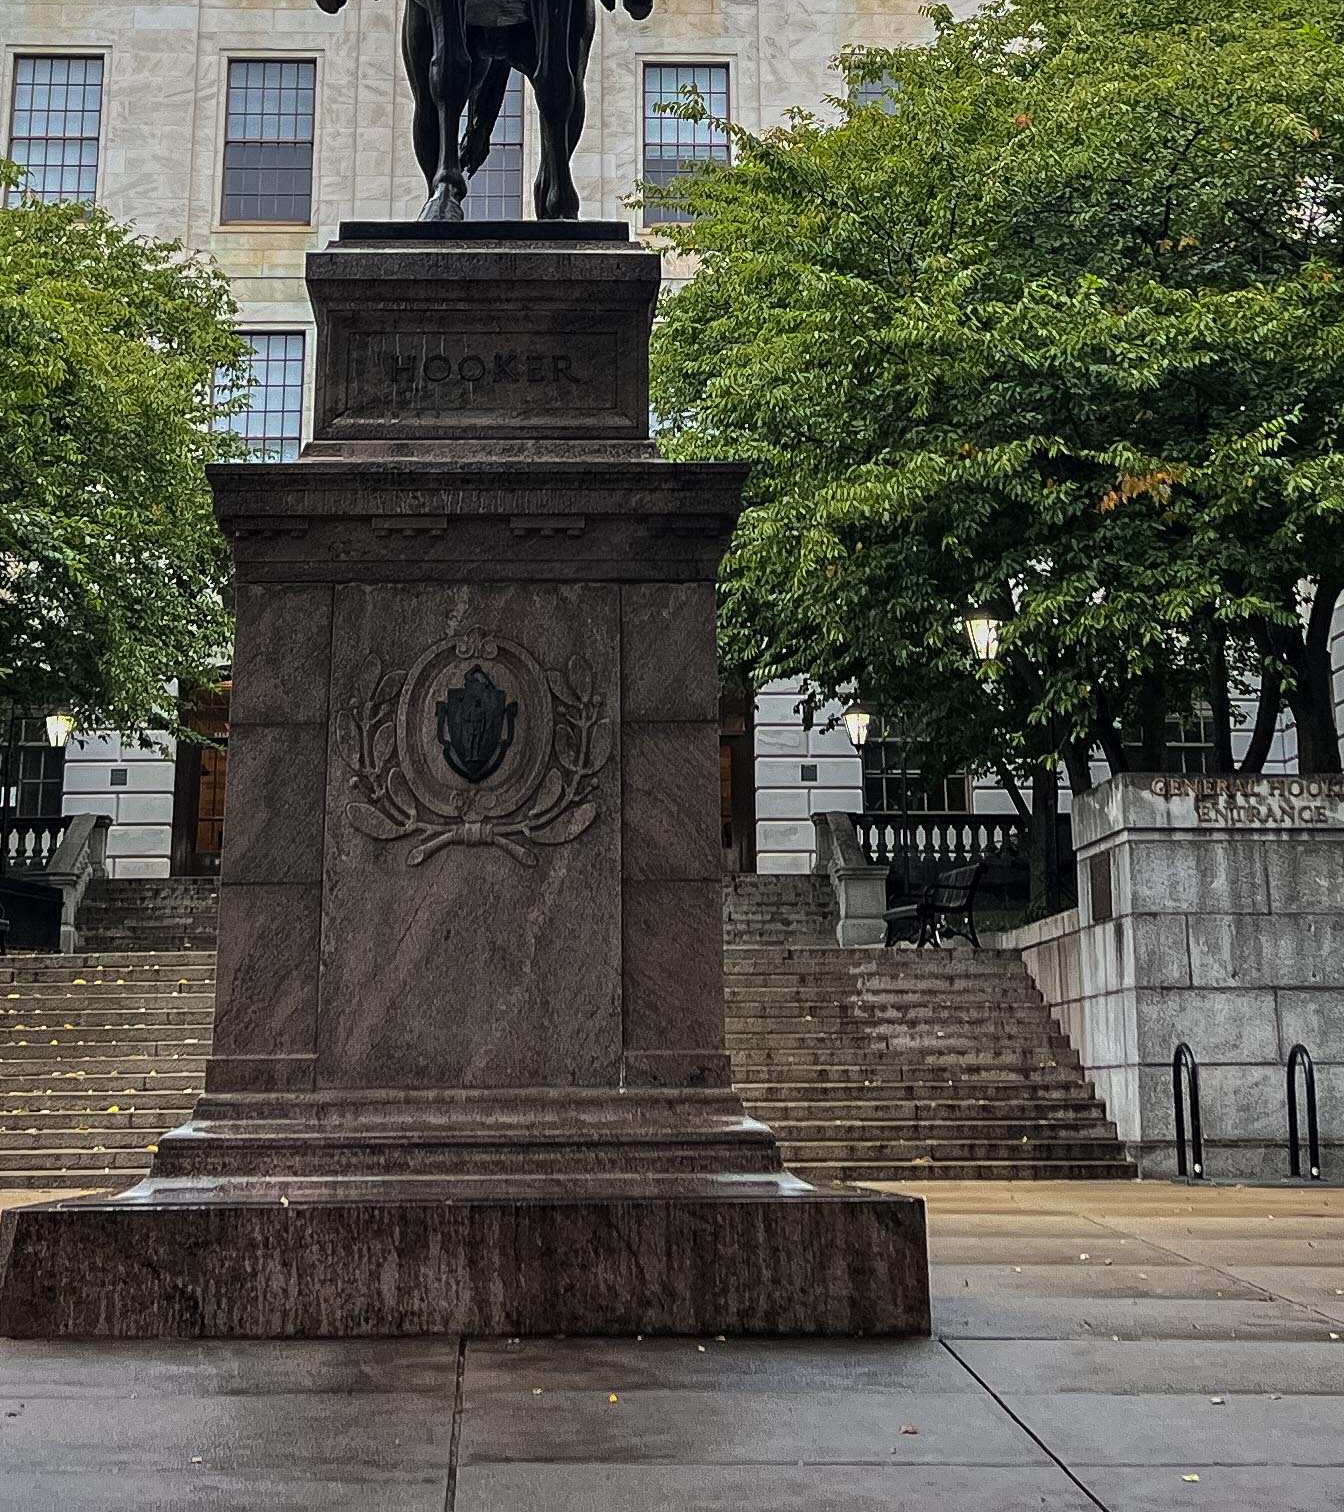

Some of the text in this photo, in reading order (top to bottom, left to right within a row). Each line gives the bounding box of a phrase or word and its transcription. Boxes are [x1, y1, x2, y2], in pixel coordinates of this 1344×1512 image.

[392, 355, 581, 383] HOOKER
[1152, 778, 1261, 797] GENERAL
[1198, 806, 1328, 823] ENTRANCE
